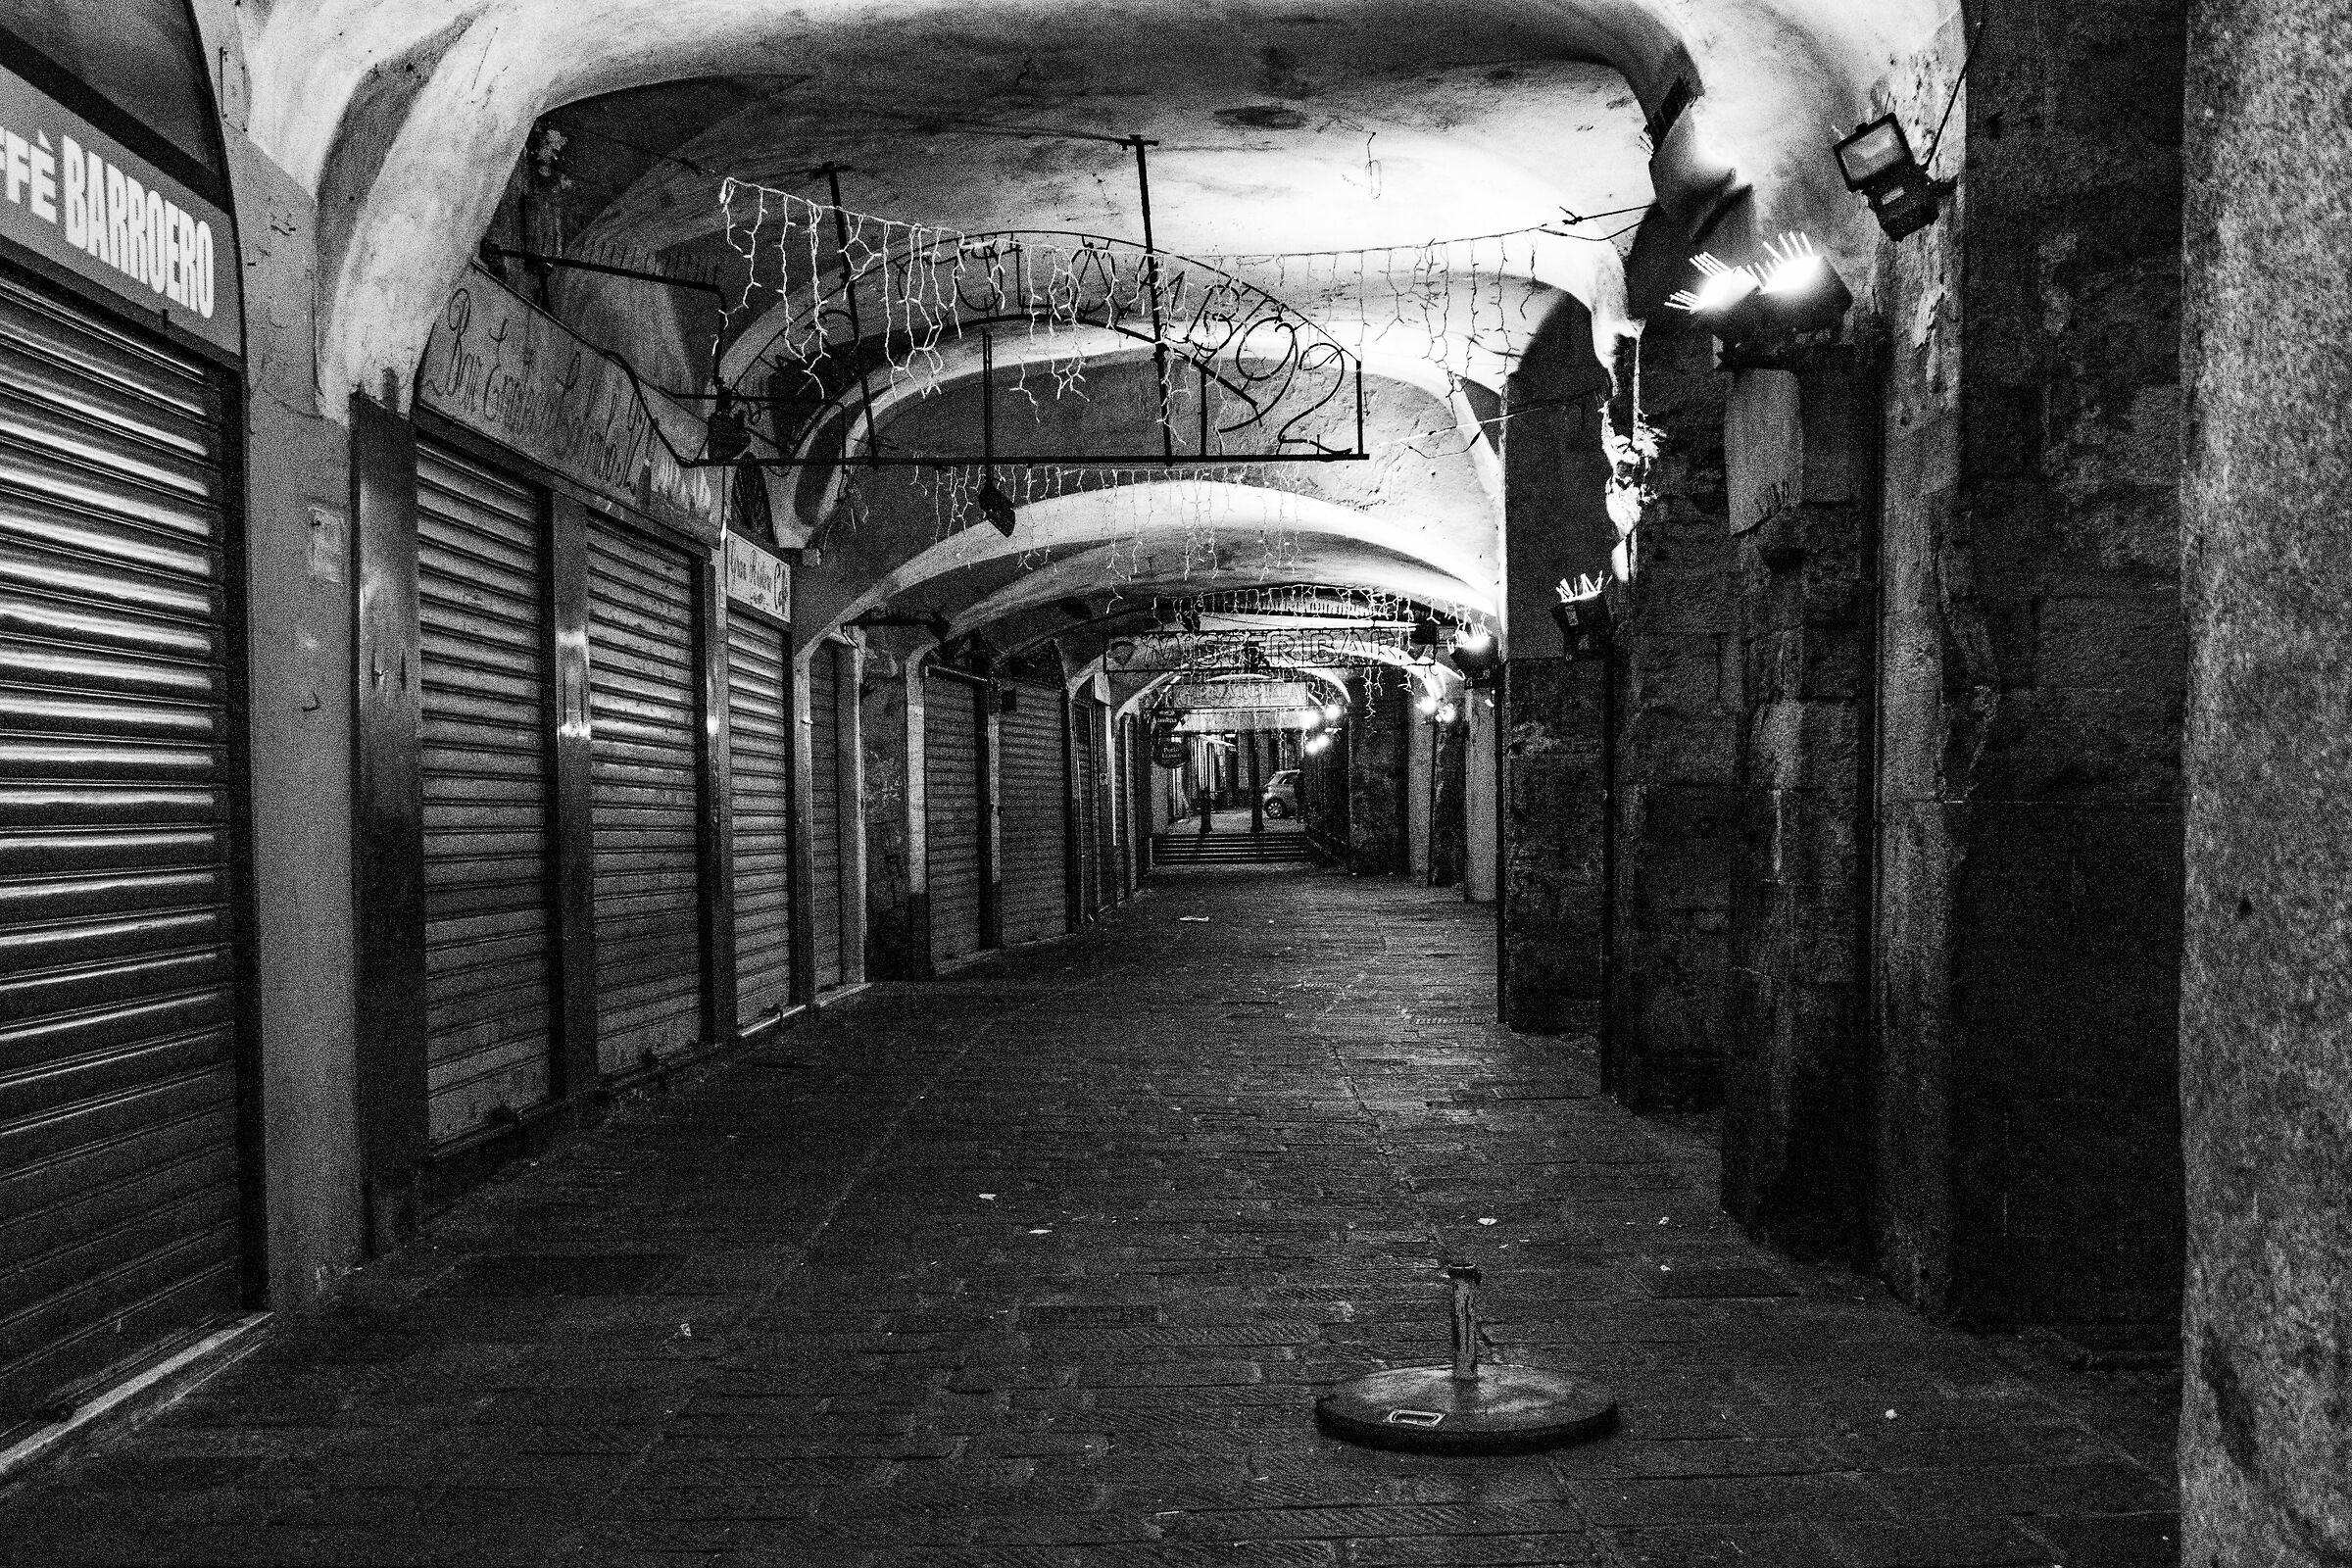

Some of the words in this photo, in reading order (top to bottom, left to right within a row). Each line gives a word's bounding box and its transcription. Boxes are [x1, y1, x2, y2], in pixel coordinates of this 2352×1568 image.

[63, 134, 214, 318] BARROERO
[422, 287, 483, 414] Bar
[1144, 632, 1296, 667] MISTER
[1309, 631, 1397, 665] BAR
